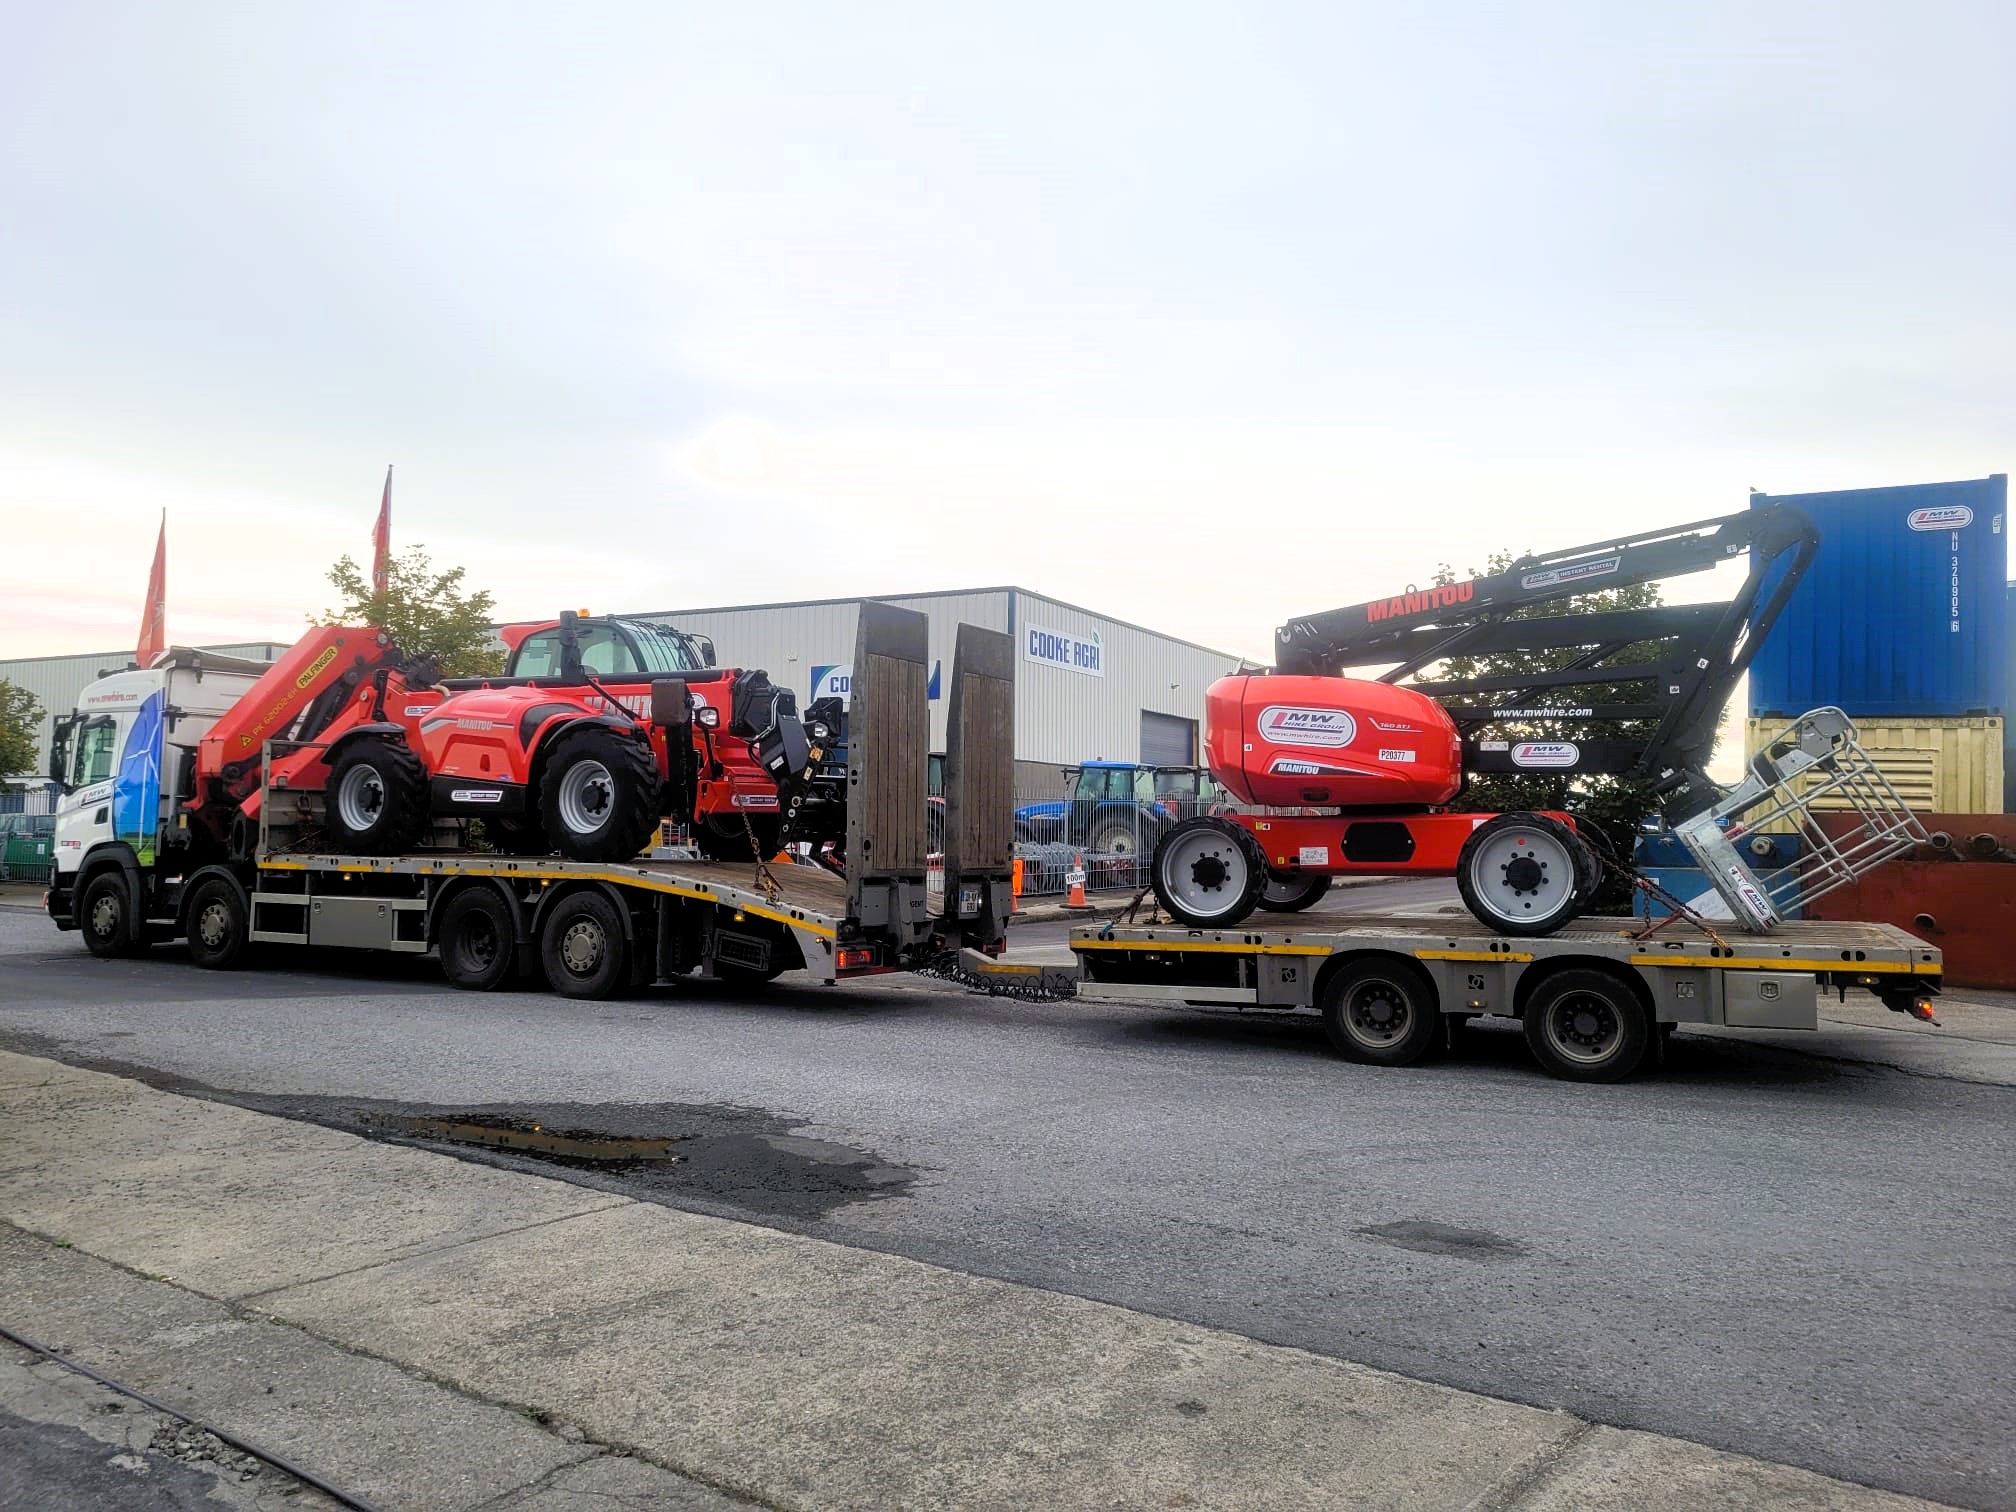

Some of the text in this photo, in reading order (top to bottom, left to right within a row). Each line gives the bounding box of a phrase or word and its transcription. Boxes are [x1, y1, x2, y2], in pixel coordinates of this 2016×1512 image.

[1367, 580, 1473, 623] MANITOU
[1029, 629, 1100, 671] COOKE AGRI
[298, 647, 336, 687] PALFINGER
[583, 695, 652, 720] MANIT
[1493, 707, 1593, 718] www.mwhire.com
[1287, 712, 1335, 723] MW
[252, 723, 264, 735] PK
[457, 718, 493, 731] MANITOU
[1267, 731, 1342, 741] www.mwhire.com
[1381, 750, 1406, 761] P20377
[1277, 763, 1320, 775] MANITOU
[1066, 873, 1085, 883] 100m
